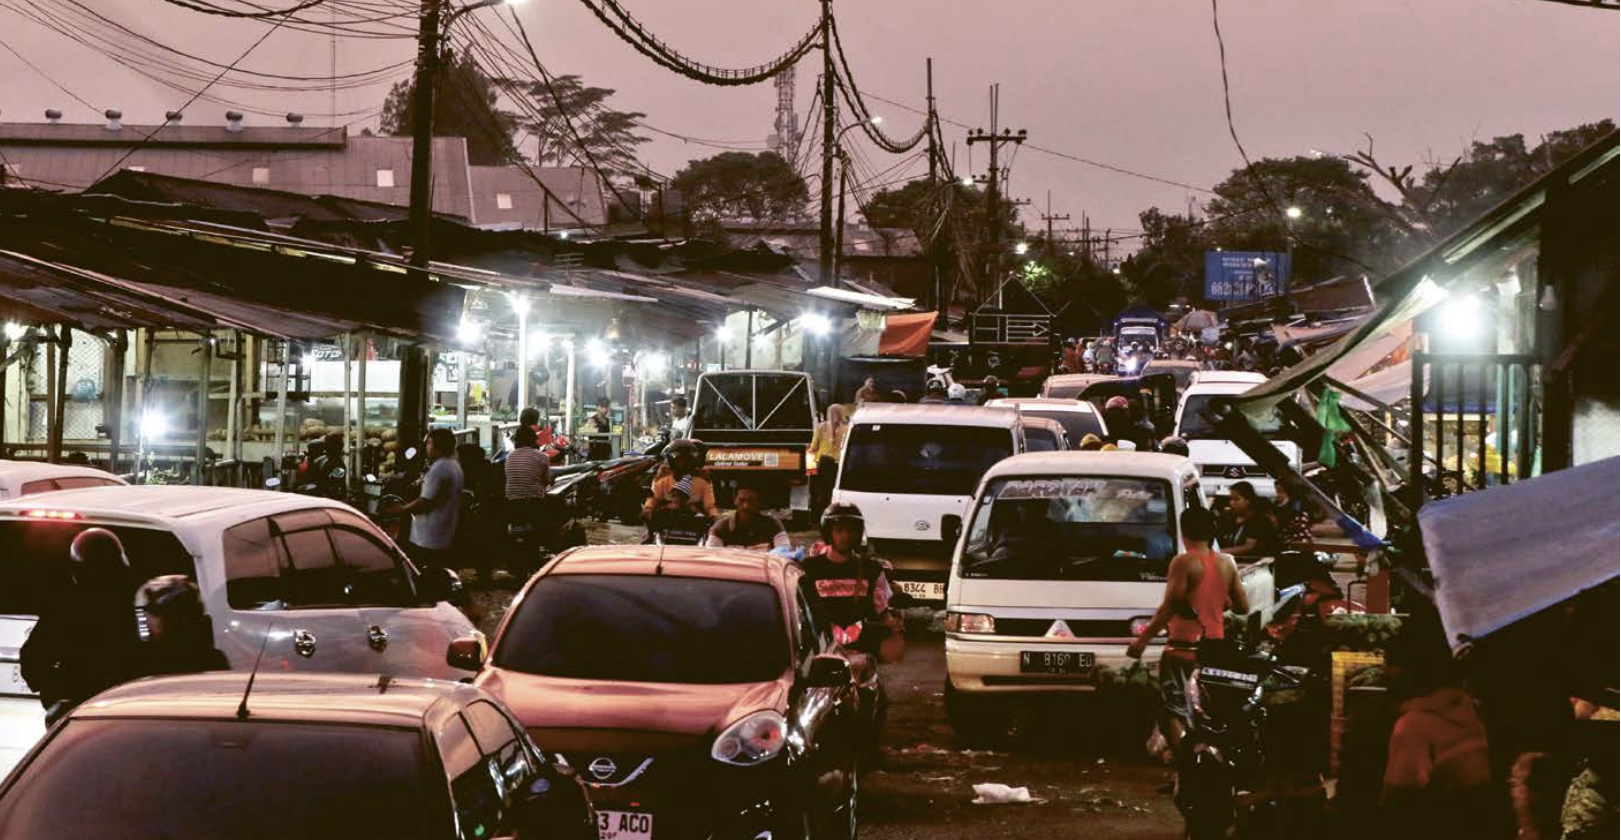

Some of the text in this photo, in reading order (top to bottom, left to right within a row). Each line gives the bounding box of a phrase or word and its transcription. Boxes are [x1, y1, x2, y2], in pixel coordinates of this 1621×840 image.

[709, 453, 763, 461] LALAMOVE
[903, 583, 926, 593] 8344
[619, 814, 650, 834] ACO
